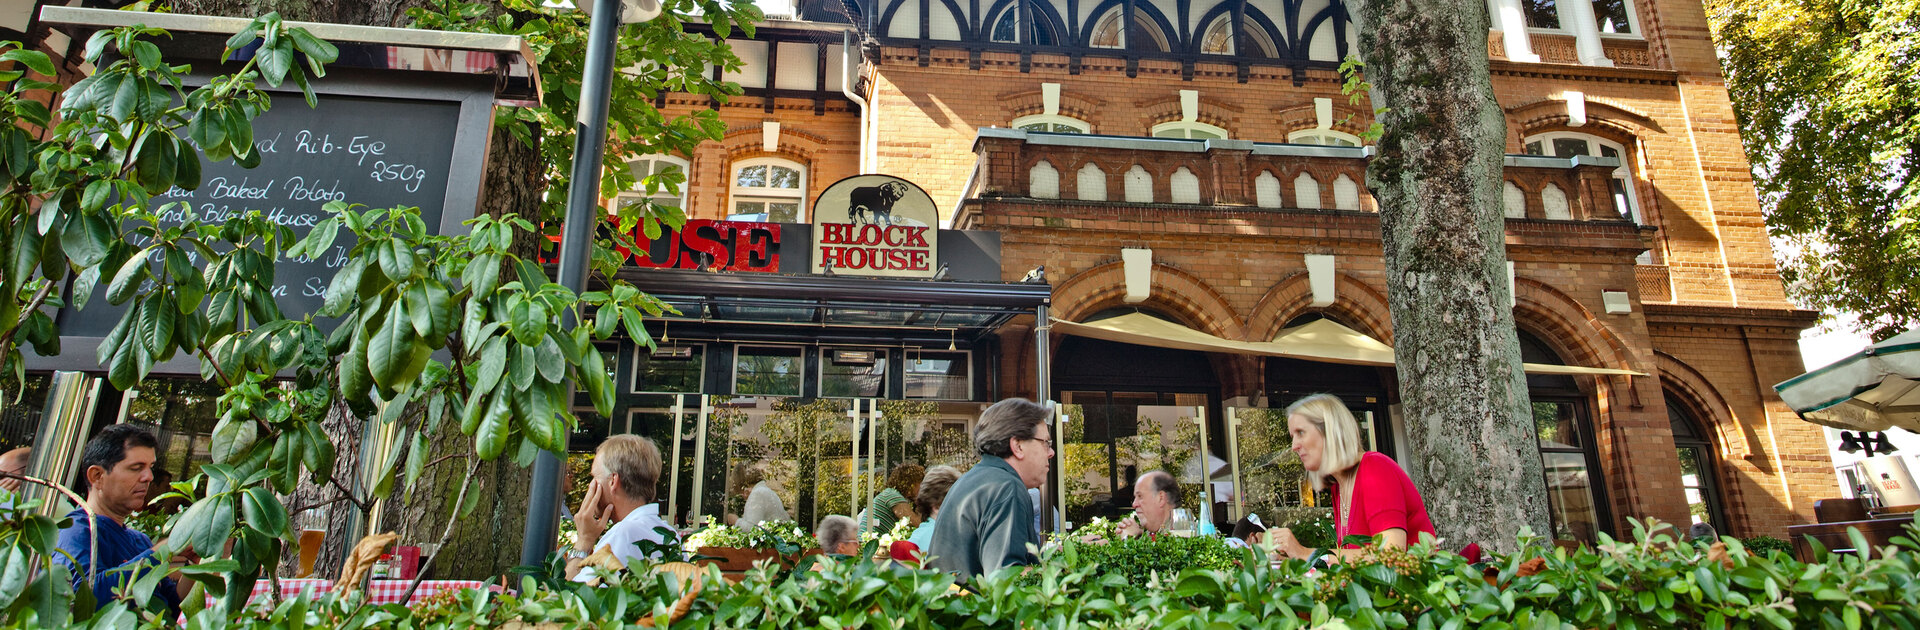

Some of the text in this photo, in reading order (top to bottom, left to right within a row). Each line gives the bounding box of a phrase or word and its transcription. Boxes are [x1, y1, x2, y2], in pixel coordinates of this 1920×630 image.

[295, 129, 386, 166] Rib-Eye
[208, 176, 274, 199] Baked
[283, 176, 345, 201] Potato
[370, 160, 426, 193] 250g
[266, 206, 318, 227] House
[820, 222, 930, 248] BLOCK
[819, 246, 930, 271] HOUSE
